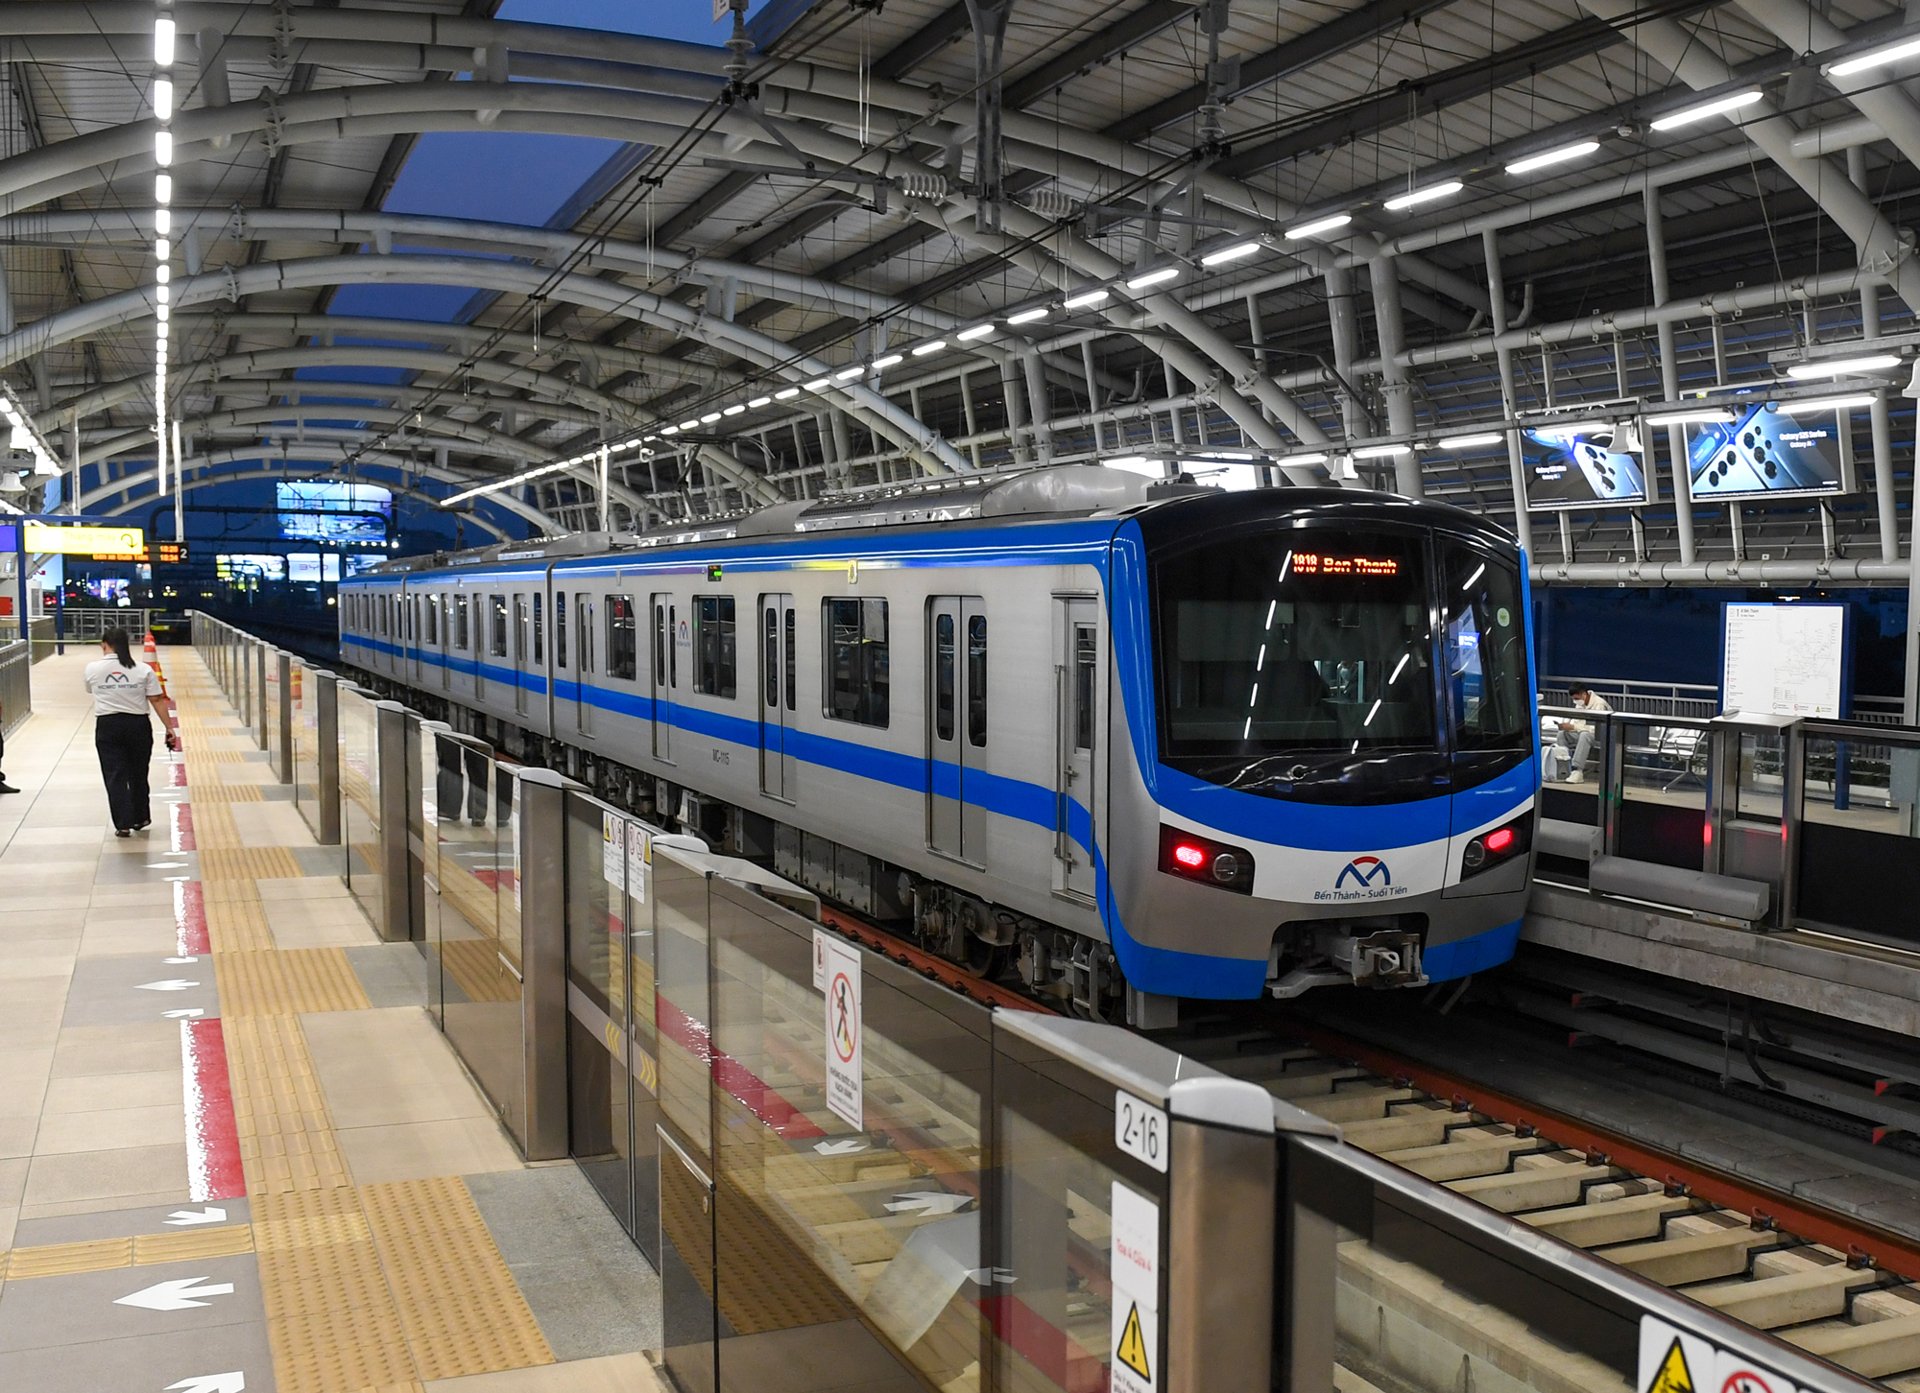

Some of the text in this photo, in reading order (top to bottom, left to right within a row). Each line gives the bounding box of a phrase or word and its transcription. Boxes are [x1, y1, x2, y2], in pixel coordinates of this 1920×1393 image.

[180, 548, 188, 559] 2
[1323, 558, 1351, 573] Ben
[1354, 557, 1397, 574] Thanh
[1123, 1102, 1158, 1160] 2-16
